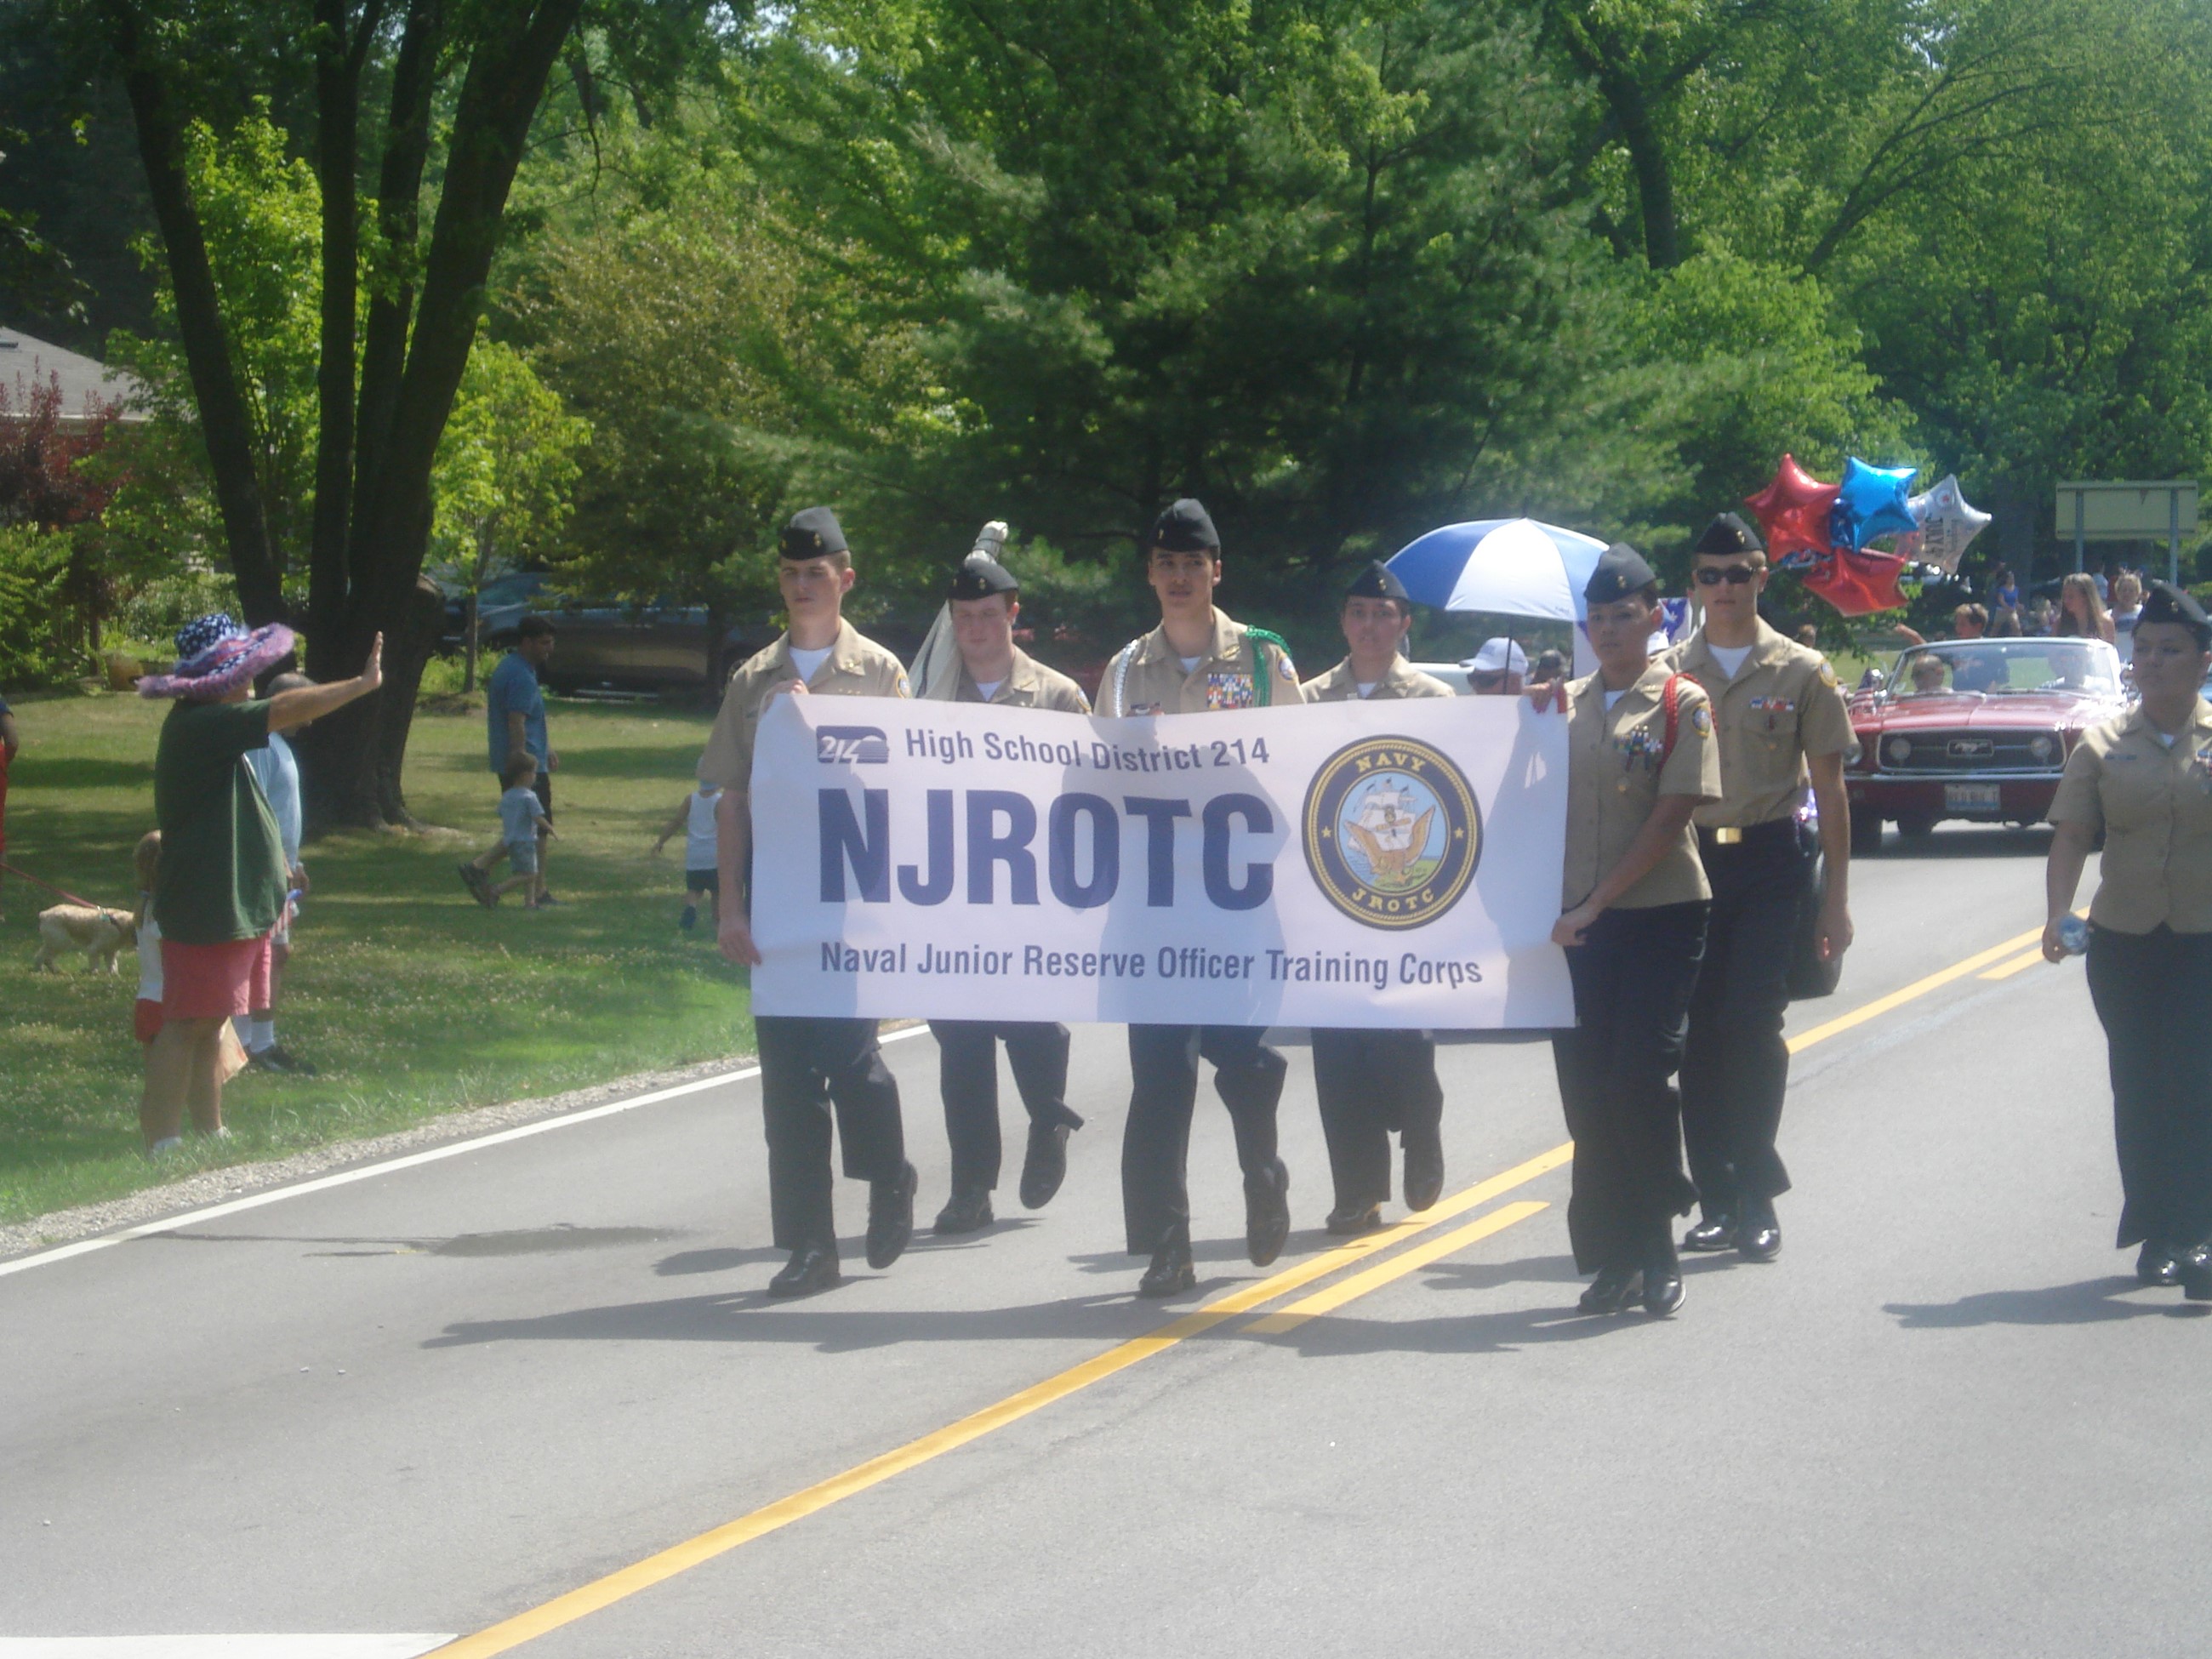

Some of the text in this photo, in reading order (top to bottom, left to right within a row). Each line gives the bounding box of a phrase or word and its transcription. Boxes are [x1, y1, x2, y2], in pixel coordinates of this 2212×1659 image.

[905, 728, 1270, 772] High School District 214
[1356, 753, 1426, 772] NAVY
[818, 788, 1274, 910] NJROTC
[1353, 888, 1434, 912] JROTC
[821, 942, 1483, 990] Naval Junior Reserve Officer Training Corps
